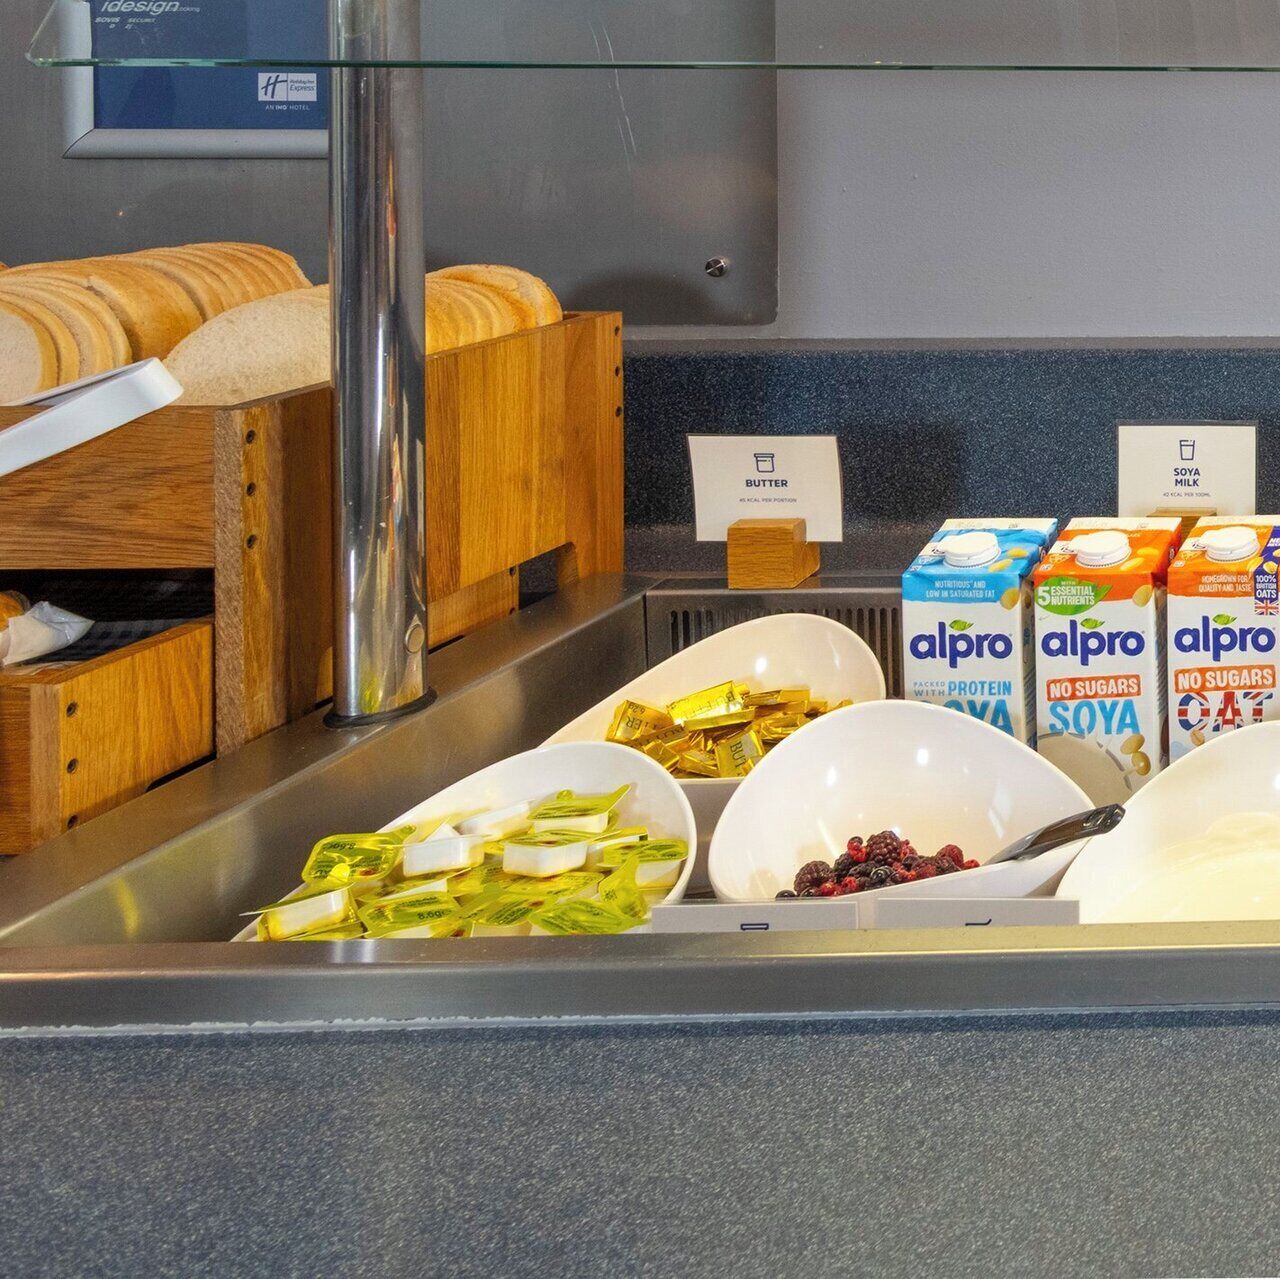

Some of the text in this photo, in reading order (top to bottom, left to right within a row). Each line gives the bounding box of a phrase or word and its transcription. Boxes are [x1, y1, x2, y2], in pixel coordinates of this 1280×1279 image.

[1173, 467, 1201, 476] SOYA
[745, 479, 788, 488] BUTTER
[1174, 478, 1200, 487] MILK
[973, 580, 986, 589] AND
[1201, 575, 1249, 583] HOMEGROWN FOR
[1255, 575, 1277, 583] 100%
[926, 590, 996, 598] LOW IN SATURATED FAT
[1051, 585, 1095, 596] ESSENTIAL
[1199, 584, 1252, 593] QUALITY AND TASTE
[1256, 590, 1277, 598] OATS
[1037, 586, 1051, 606] 5
[1051, 595, 1095, 606] NUTRIENTS
[1041, 619, 1146, 666] alpro
[1174, 615, 1276, 662] alpro
[909, 621, 1013, 669] alpro
[1177, 669, 1273, 691] NO SUGARS
[913, 680, 1012, 697] WITH PROTEIN
[1050, 678, 1138, 699] NO SUGARS
[1048, 699, 1140, 735] SOYA
[1177, 691, 1274, 732] OAT
